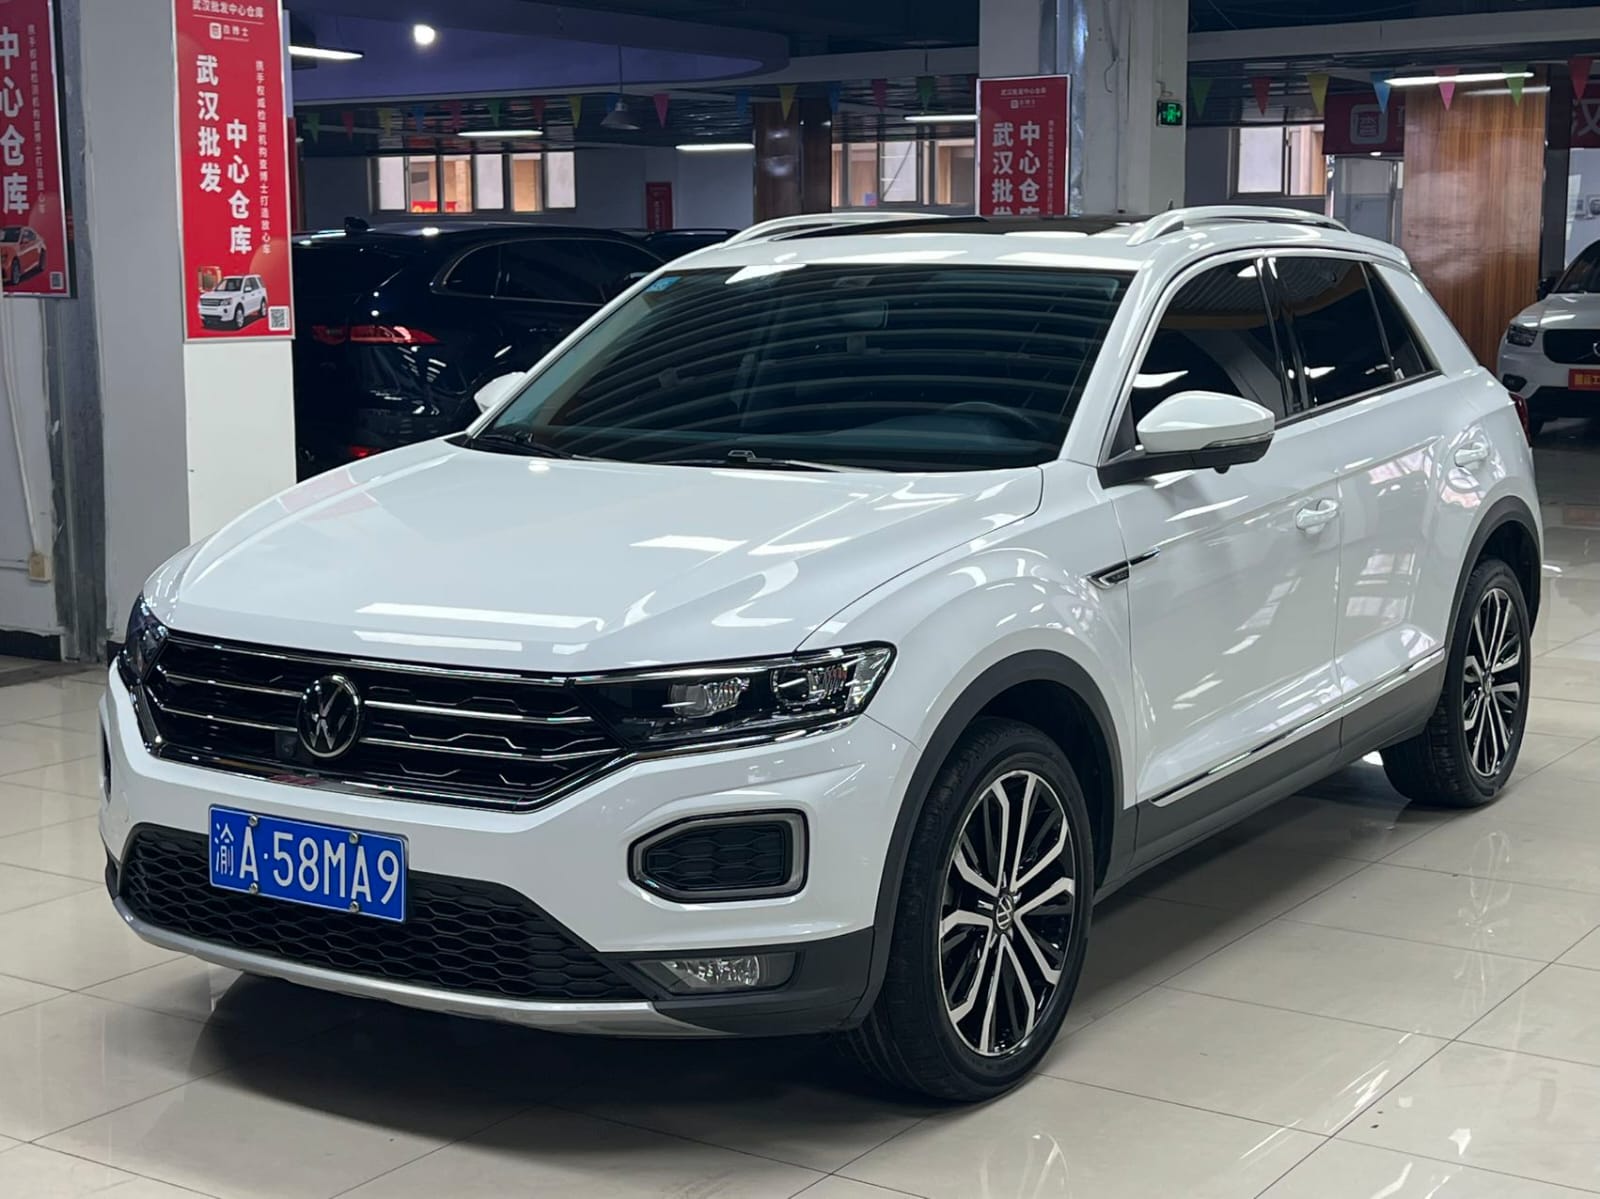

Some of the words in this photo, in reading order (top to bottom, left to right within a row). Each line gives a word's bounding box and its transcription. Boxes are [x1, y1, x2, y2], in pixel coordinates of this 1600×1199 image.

[0, 26, 30, 215] 中心仓库
[196, 54, 223, 194] 武汉批发
[226, 118, 253, 255] 中心仓库
